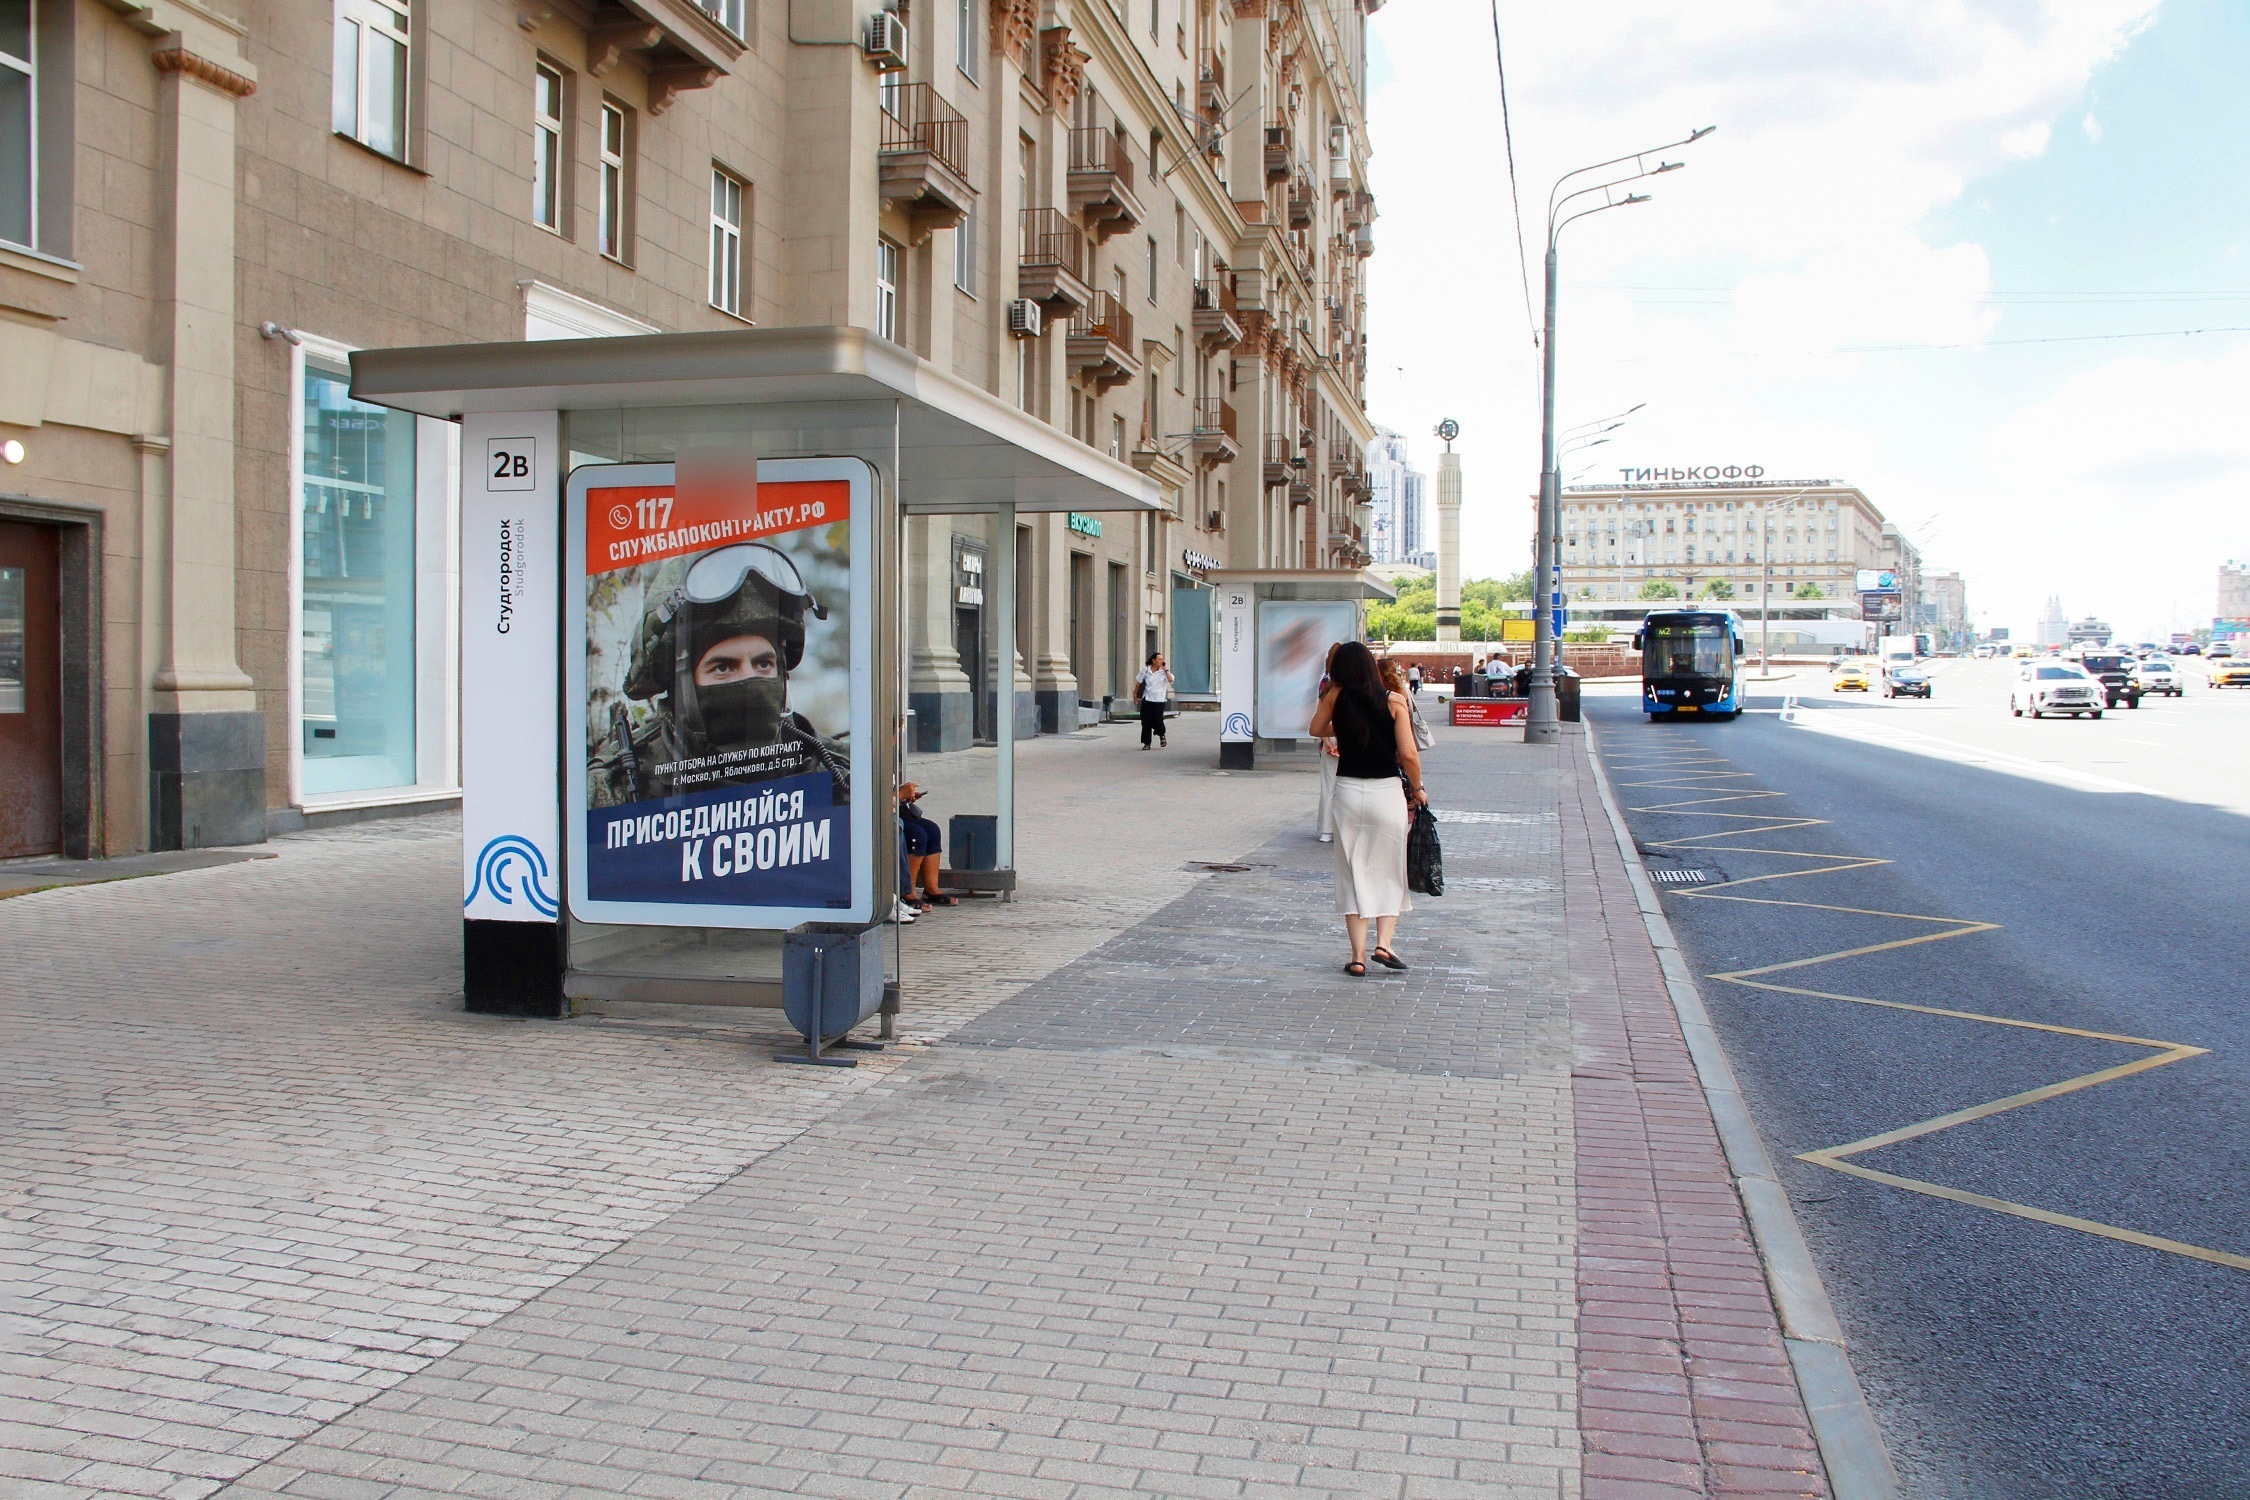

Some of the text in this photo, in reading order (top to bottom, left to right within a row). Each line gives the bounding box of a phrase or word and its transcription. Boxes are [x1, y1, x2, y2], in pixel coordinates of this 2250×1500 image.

[1619, 464, 1765, 482] ТИНЬКОФФ
[609, 501, 826, 561] СЛУЖБАПОКОНТРАКТУ.РФ
[635, 497, 674, 529] 117
[497, 518, 513, 635] Студгородок
[515, 518, 527, 597] Studgorodok
[654, 740, 804, 775] ПУНКТ ОТБОРА НА СЛУЖБУ ПО КОНТРАКТУ:
[673, 776, 679, 786] г.
[680, 771, 711, 784] Москва,
[712, 769, 723, 781] ул.
[781, 757, 797, 771] стр.
[607, 788, 804, 850] ПРИСОЕДИНЯЙСЯ
[682, 818, 831, 882] К СВОИМ
